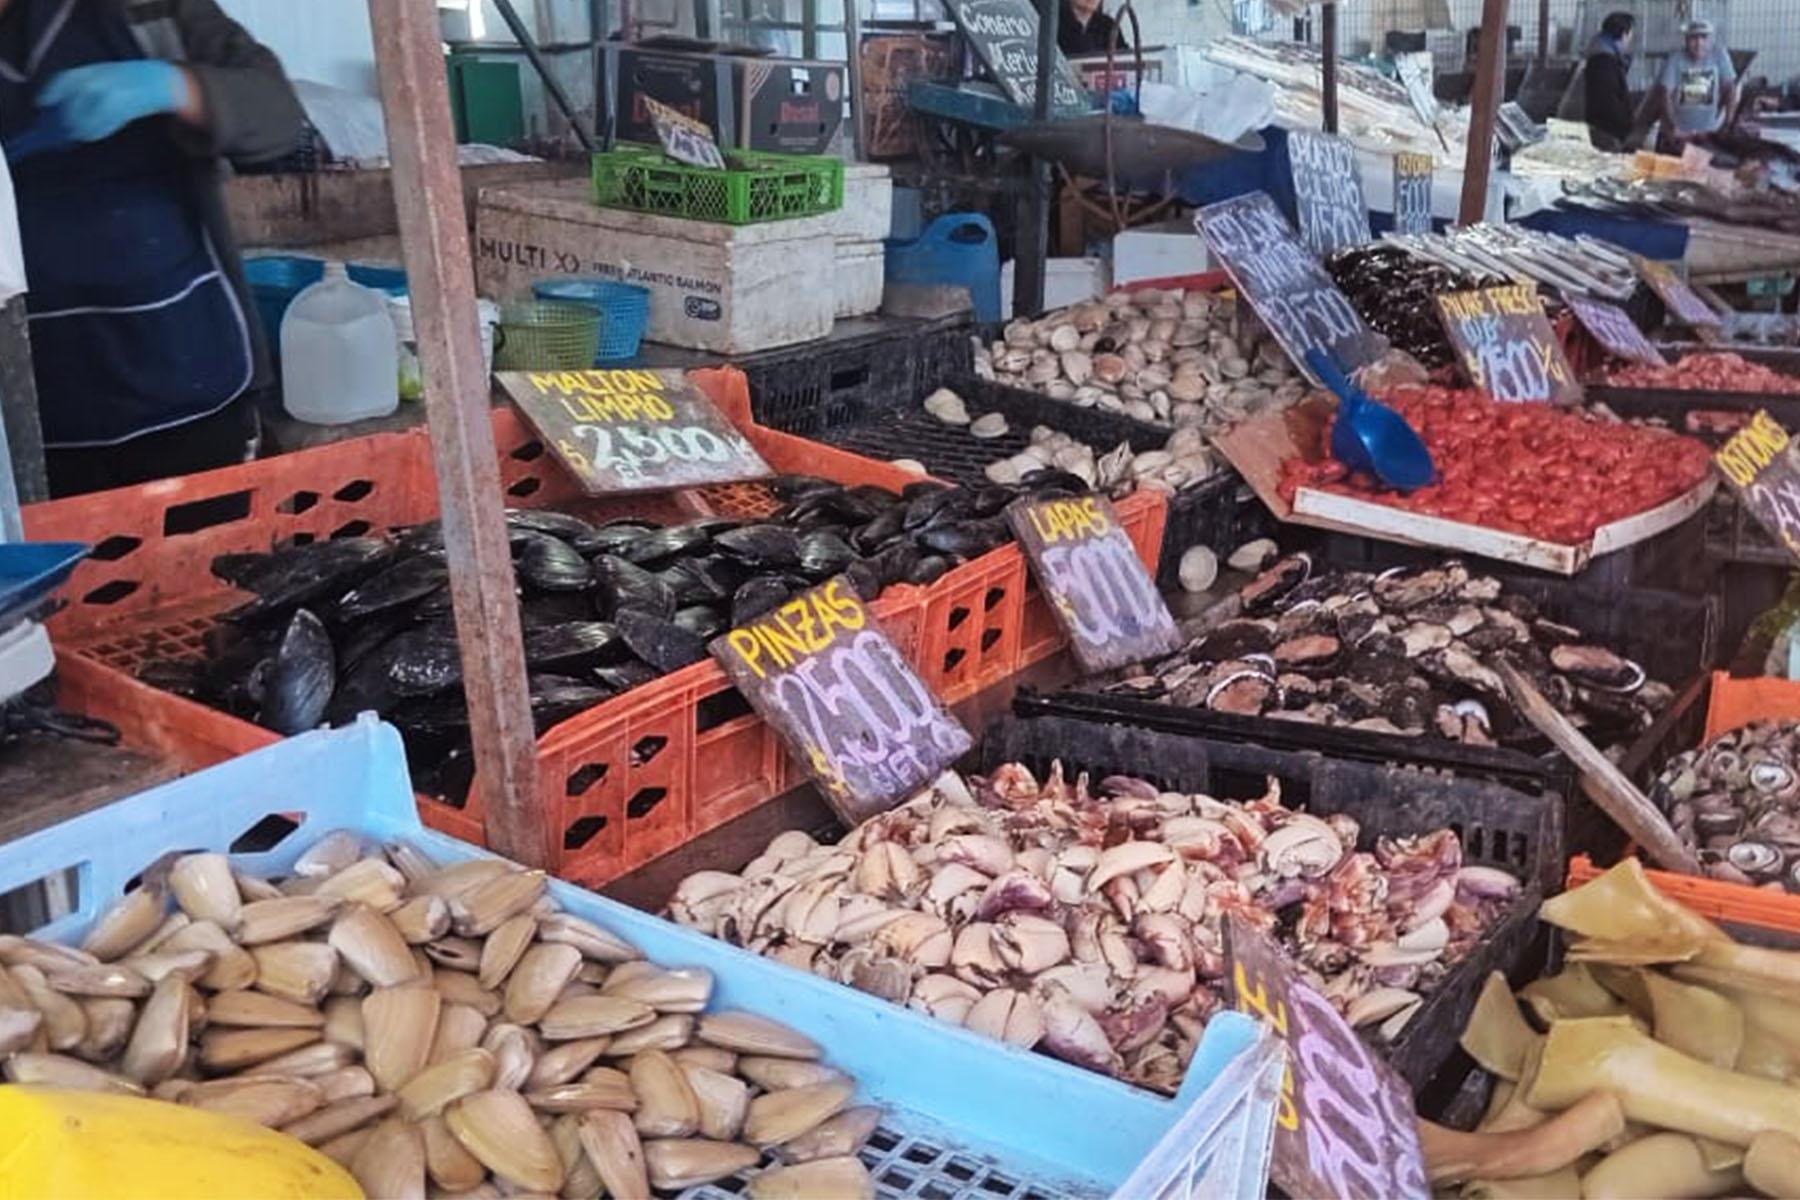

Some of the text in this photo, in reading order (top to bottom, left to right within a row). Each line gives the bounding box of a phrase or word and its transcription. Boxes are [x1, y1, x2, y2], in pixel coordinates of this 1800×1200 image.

[480, 238, 546, 269] MULTI
[627, 268, 674, 287] ATLANTIC
[676, 276, 722, 294] SALMON
[529, 369, 664, 395] MALTON
[561, 394, 675, 423] LIMPIO
[1027, 496, 1108, 543] LAPAS
[727, 580, 865, 679] PINZAS
